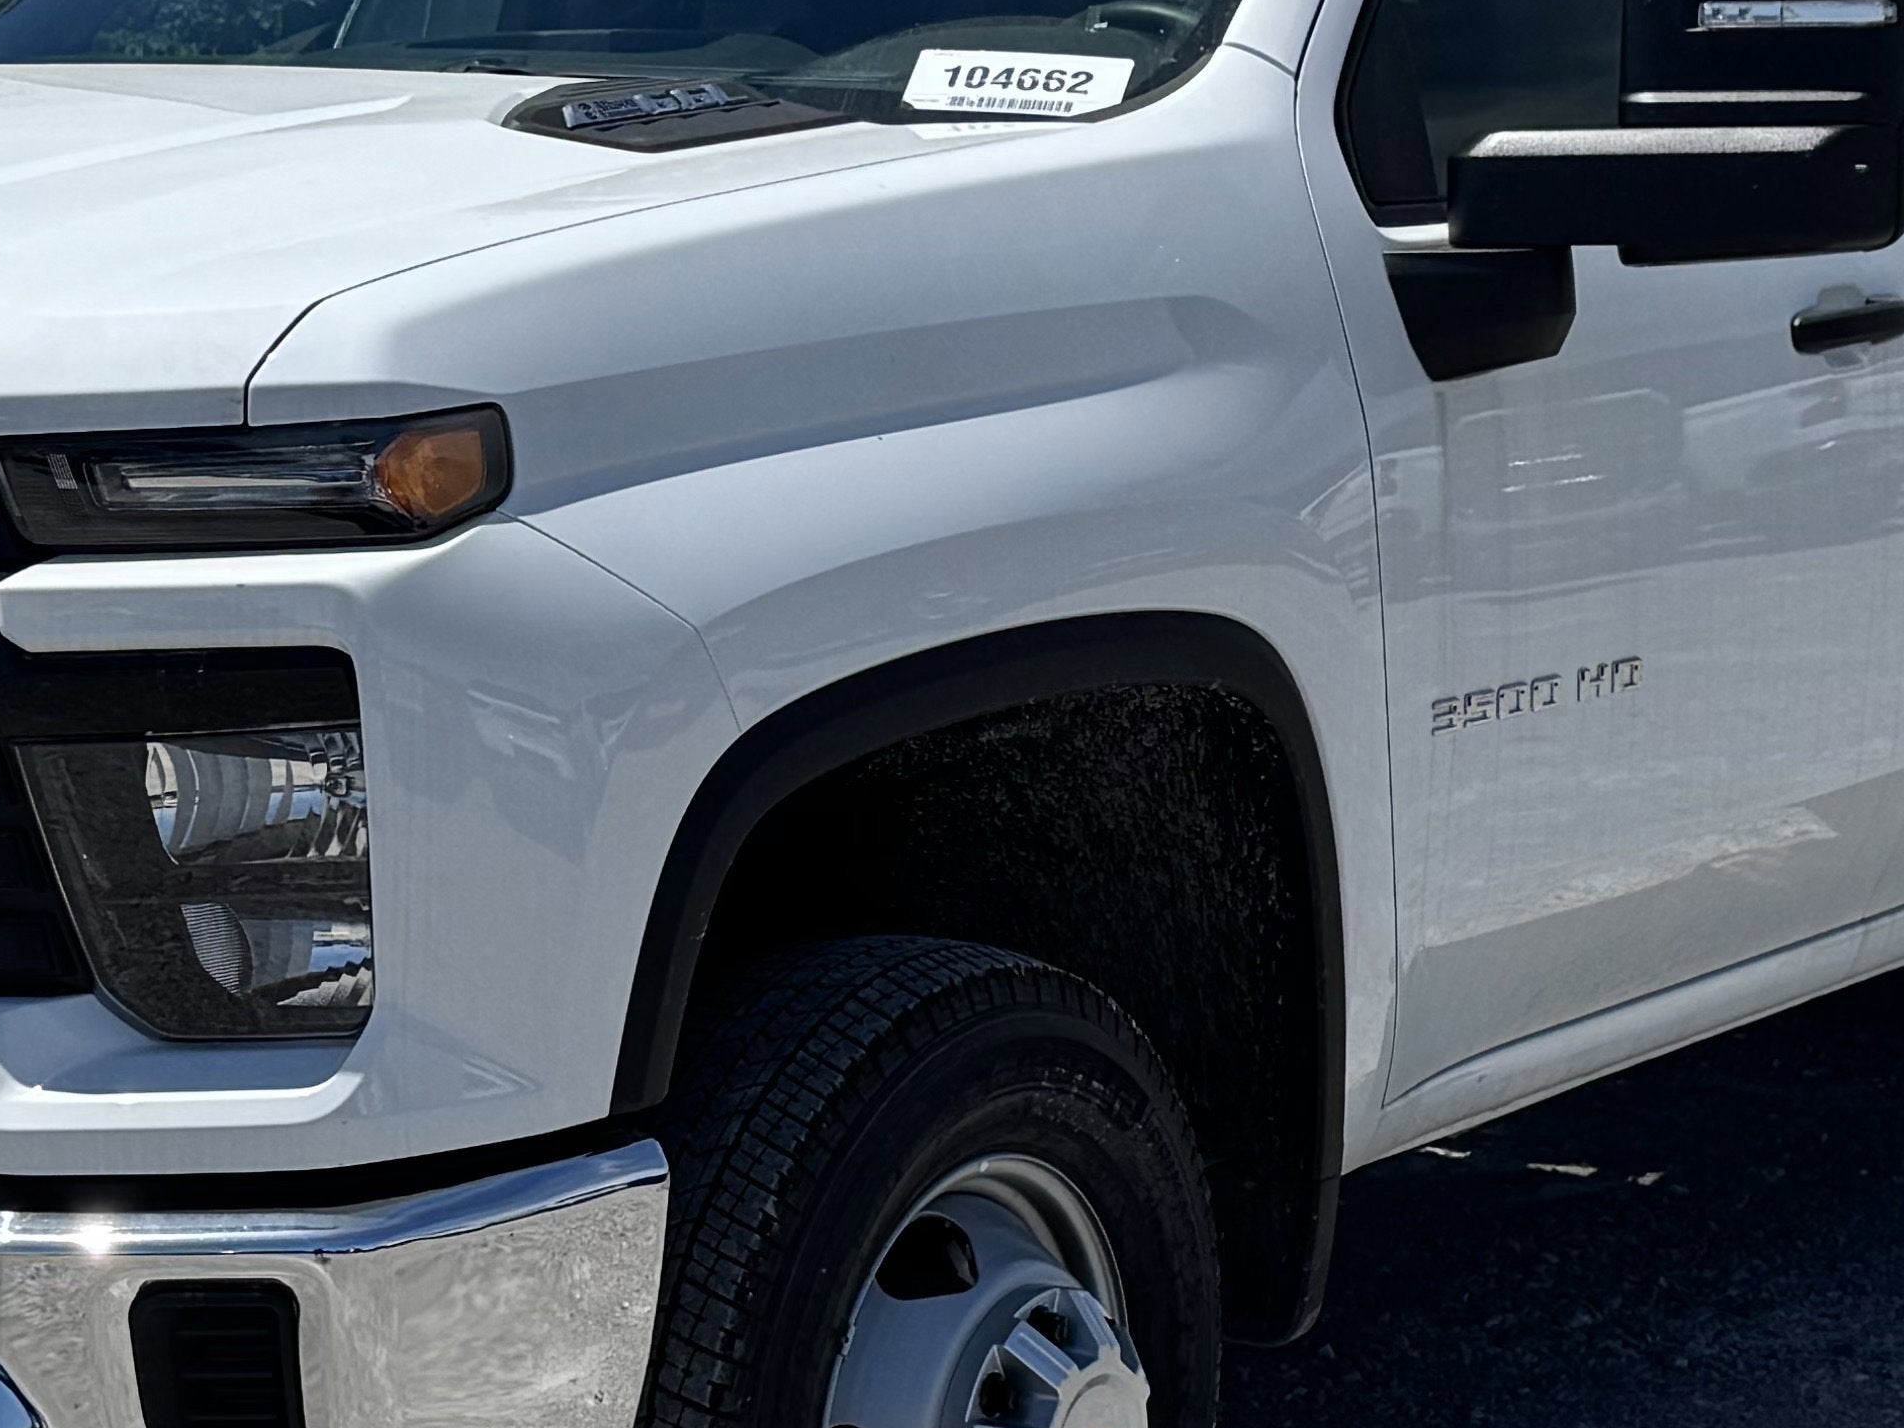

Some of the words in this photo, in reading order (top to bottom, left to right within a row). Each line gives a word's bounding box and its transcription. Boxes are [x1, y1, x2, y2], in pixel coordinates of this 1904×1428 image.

[944, 65, 1094, 95] 104662
[1431, 673, 1562, 736] 3500
[1576, 655, 1643, 702] HD
